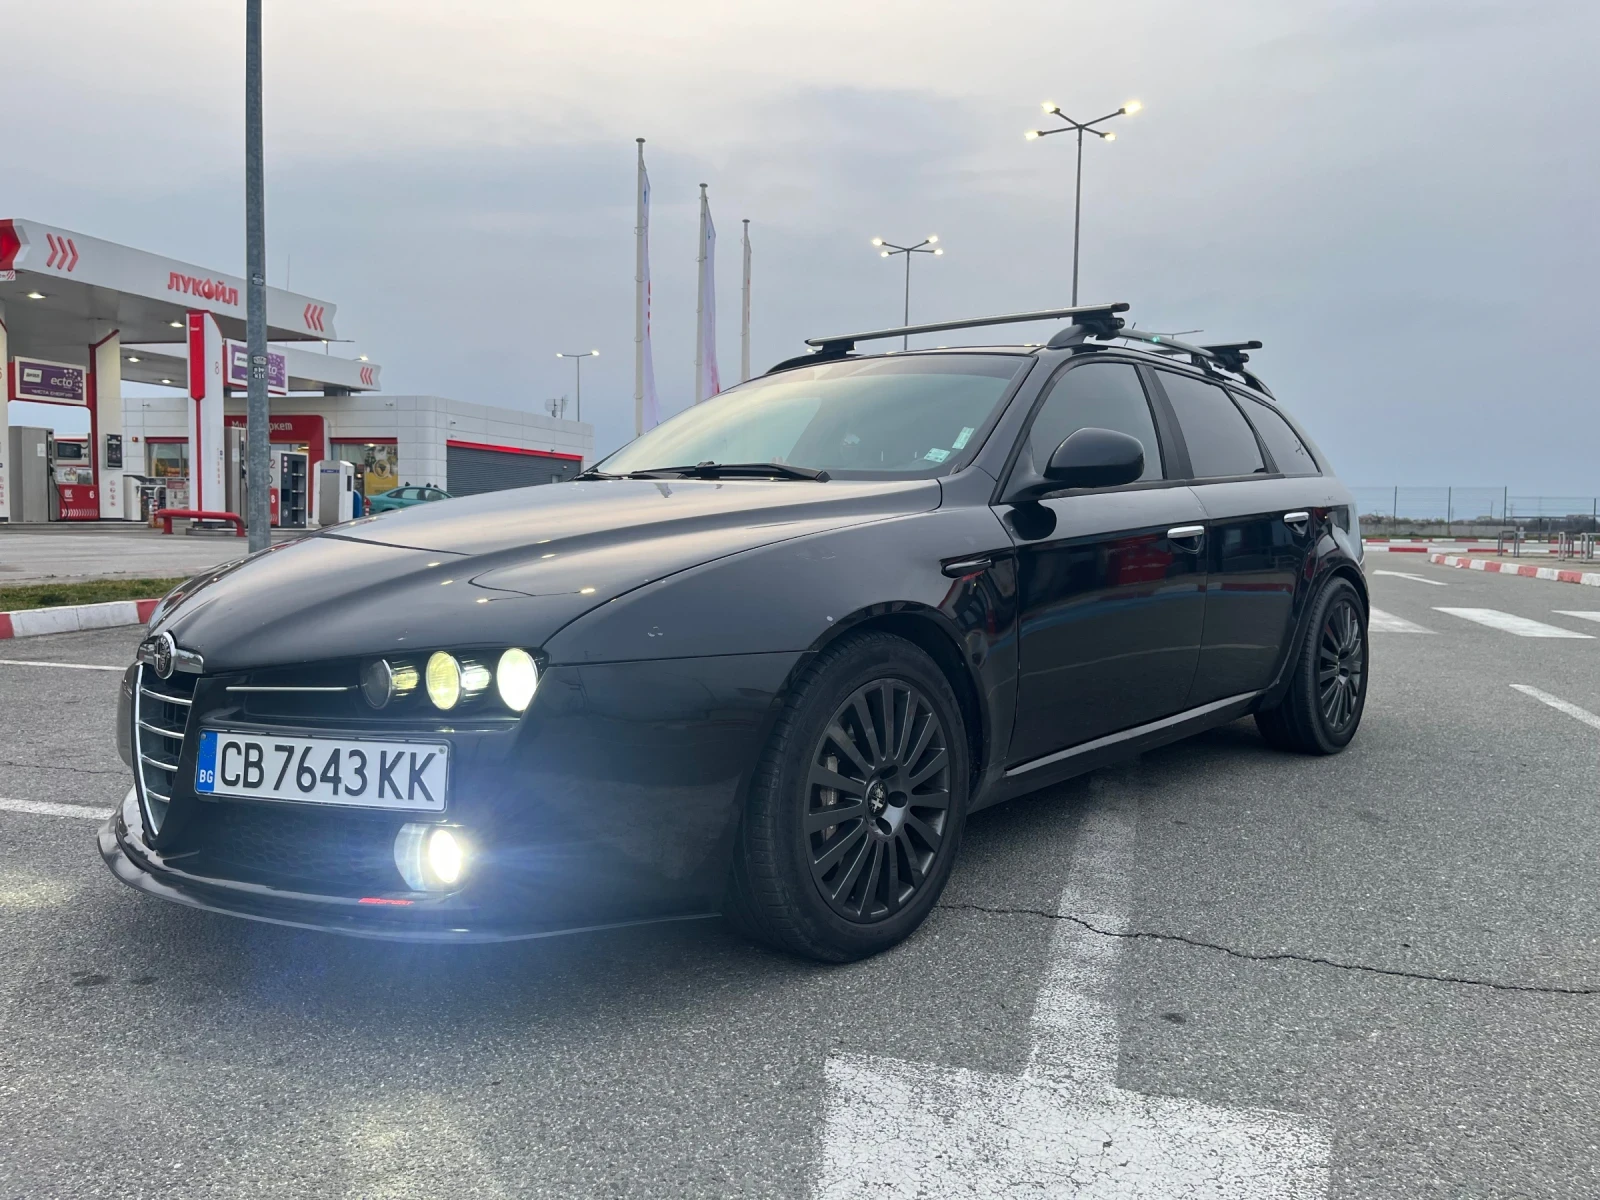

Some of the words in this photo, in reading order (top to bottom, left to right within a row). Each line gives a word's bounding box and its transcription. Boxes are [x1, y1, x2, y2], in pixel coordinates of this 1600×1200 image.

[50, 377, 73, 387] ecto
[199, 769, 214, 784] BG
[272, 743, 368, 797] 7643
[377, 750, 437, 802] KK
